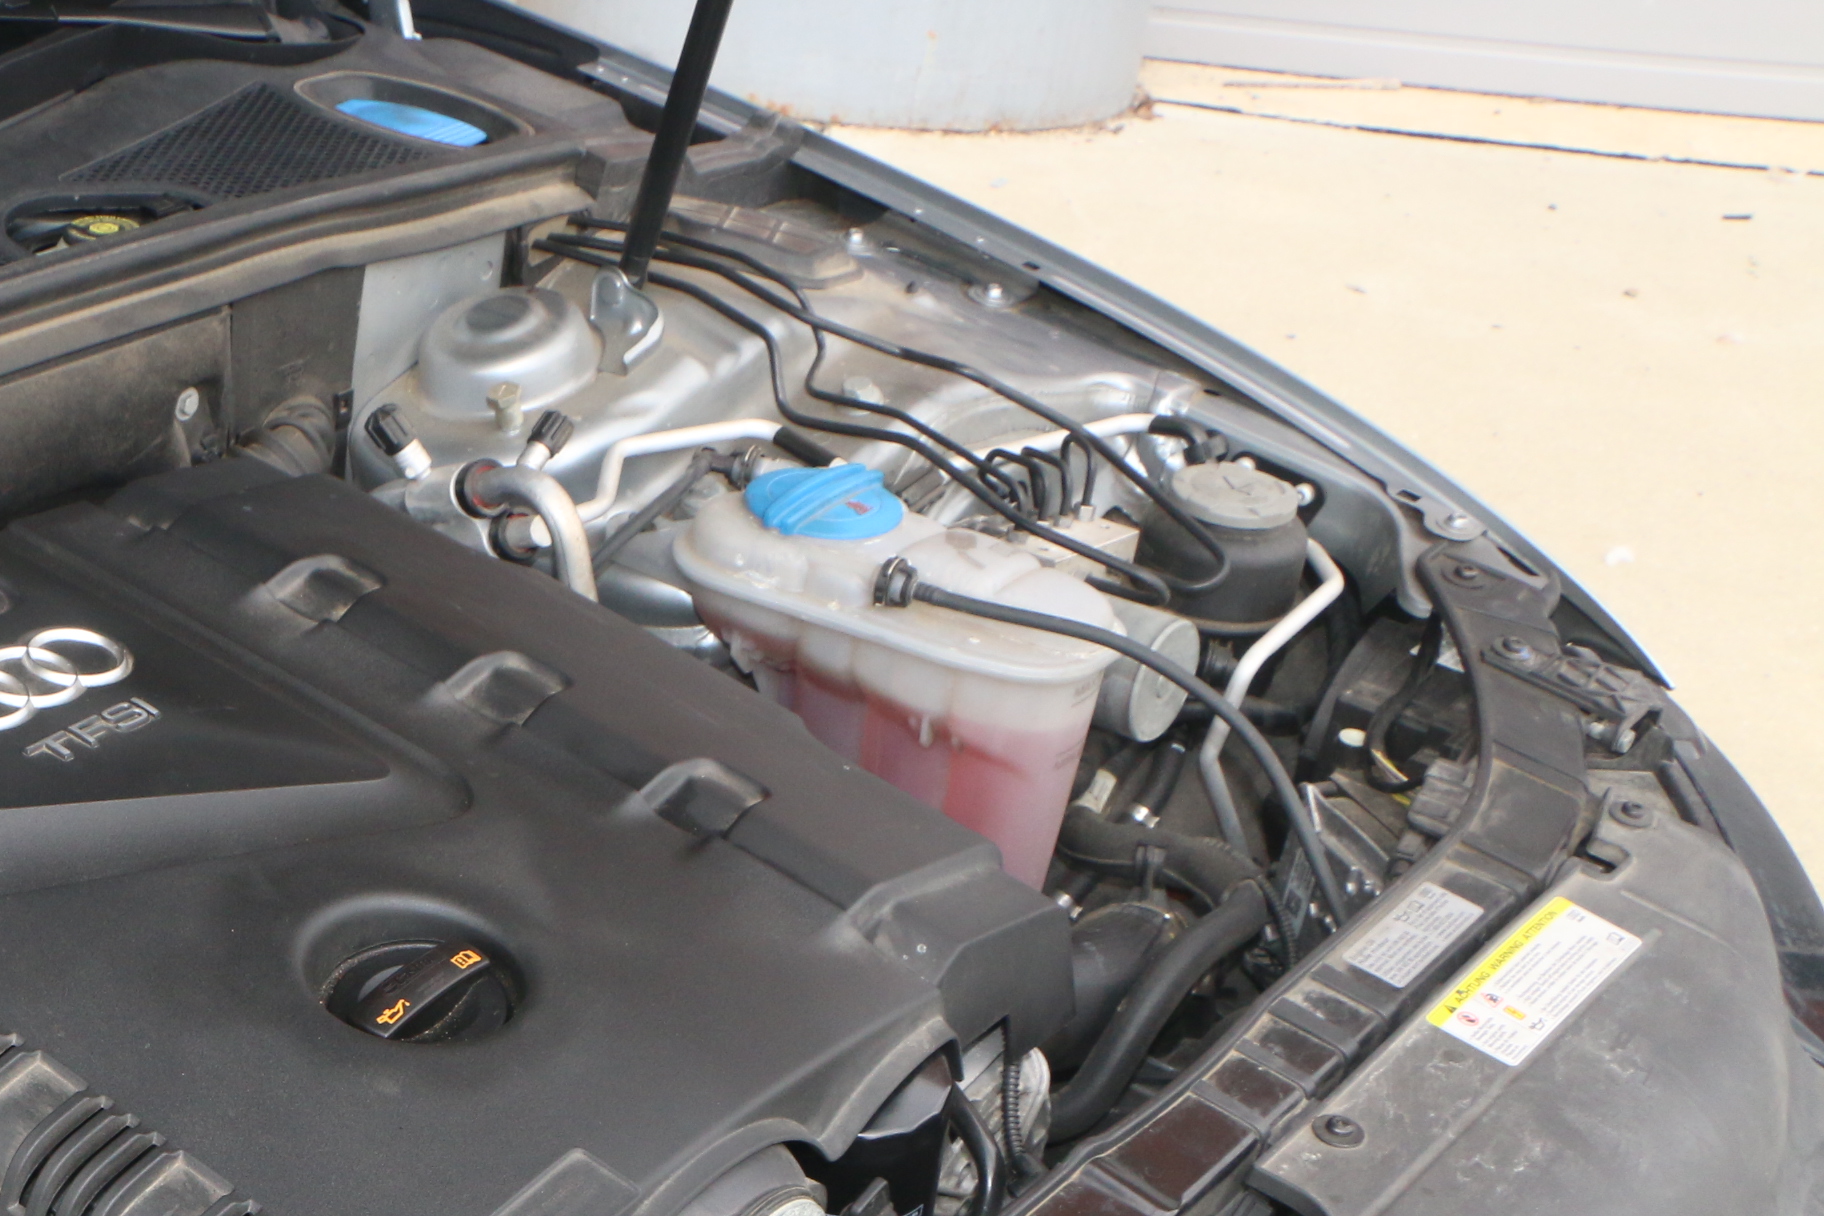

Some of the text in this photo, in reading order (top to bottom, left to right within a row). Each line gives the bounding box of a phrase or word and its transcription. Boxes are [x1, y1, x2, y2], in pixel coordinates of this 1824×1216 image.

[22, 697, 162, 763] TFSI
[1455, 911, 1557, 1004] ACHTUNG WARNING ATTENTION
